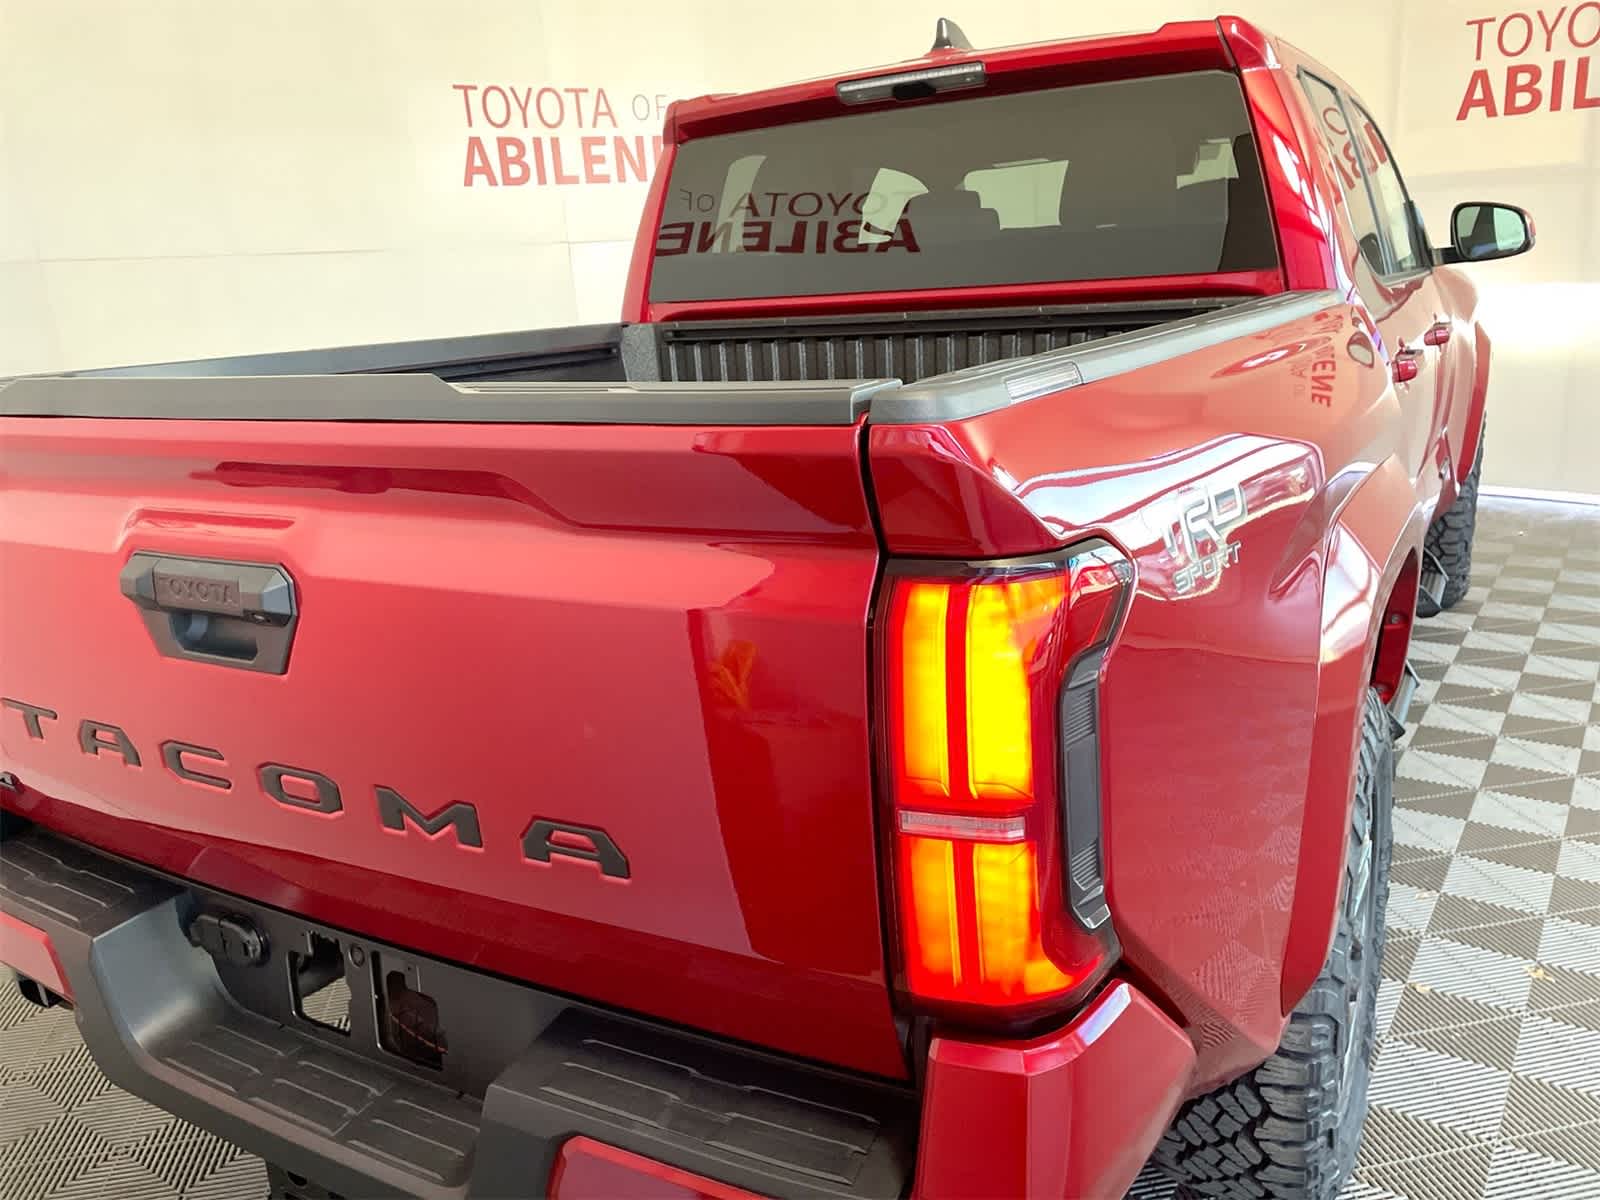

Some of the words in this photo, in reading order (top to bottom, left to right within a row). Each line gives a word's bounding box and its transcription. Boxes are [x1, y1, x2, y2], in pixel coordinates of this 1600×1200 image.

[452, 84, 619, 129] TOYOTA
[632, 93, 668, 121] OF
[1143, 482, 1248, 563] TRD
[159, 576, 240, 609] TOYOTA
[1173, 540, 1242, 595] SPORT
[1, 697, 631, 881] TACOMA
